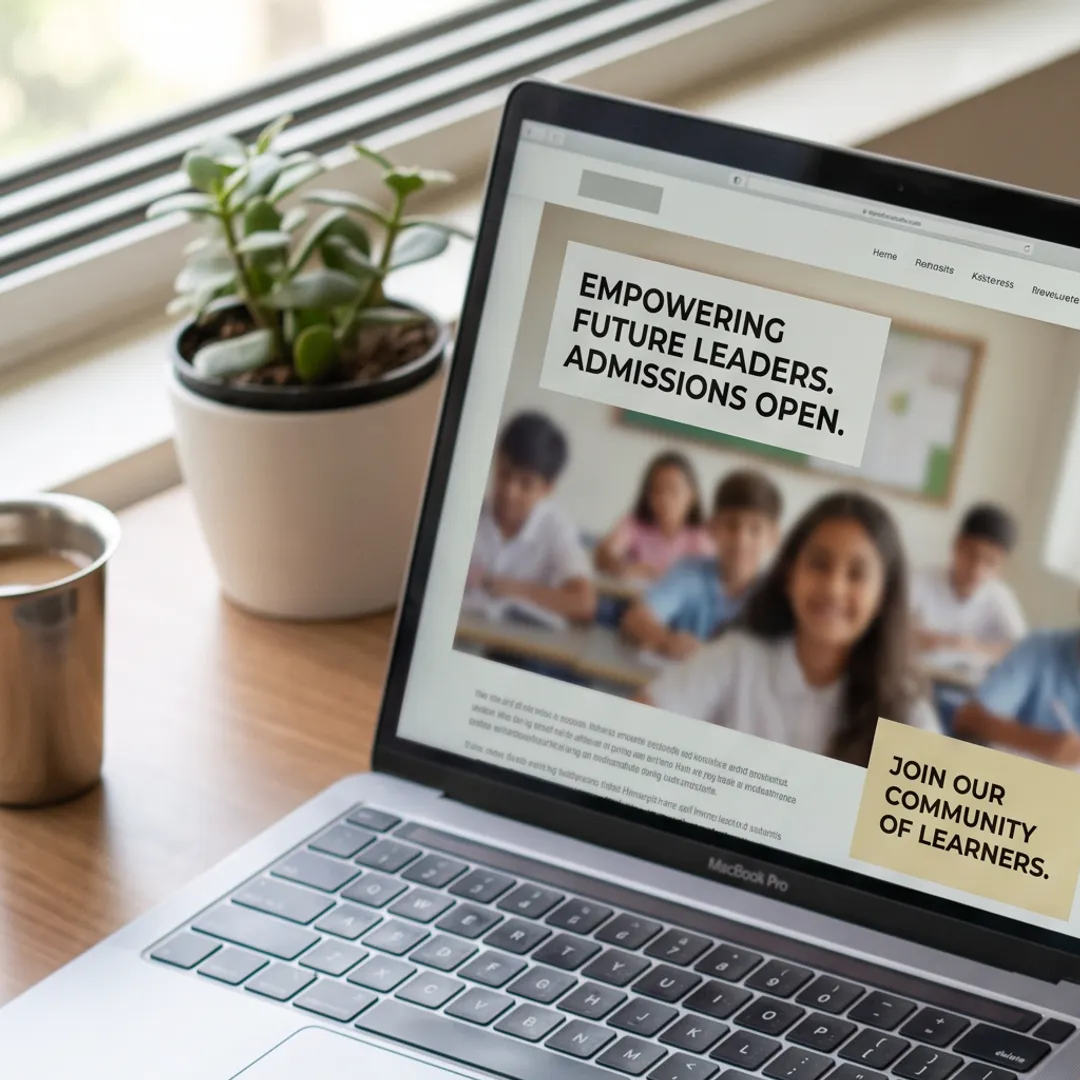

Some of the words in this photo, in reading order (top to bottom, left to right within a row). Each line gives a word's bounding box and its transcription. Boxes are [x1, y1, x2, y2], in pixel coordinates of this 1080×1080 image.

[579, 272, 786, 343] EMPOWERING
[572, 308, 687, 358] FUTURE
[693, 337, 834, 395] LEADERS.
[563, 345, 748, 411] ADMISSIONS
[755, 392, 844, 436] OPEN.
[889, 756, 947, 788] JOIN
[953, 775, 1006, 806] OUR
[885, 786, 1037, 843] COMMUNITY
[879, 814, 913, 838] OF
[918, 824, 1049, 880] LEARNERS.
[708, 857, 765, 884] MacBook
[767, 873, 789, 892] Pro
[509, 930, 525, 941] R
[561, 945, 576, 956] T
[612, 961, 626, 972] Y
[659, 978, 676, 988] U
[423, 984, 438, 995] C
[584, 995, 601, 1006] H
[761, 1011, 777, 1021] O
[522, 1017, 537, 1028] B
[686, 1028, 702, 1038] K
[813, 1026, 828, 1036] P
[572, 1033, 588, 1045] N
[622, 1049, 642, 1060] M
[739, 1044, 750, 1054] L
